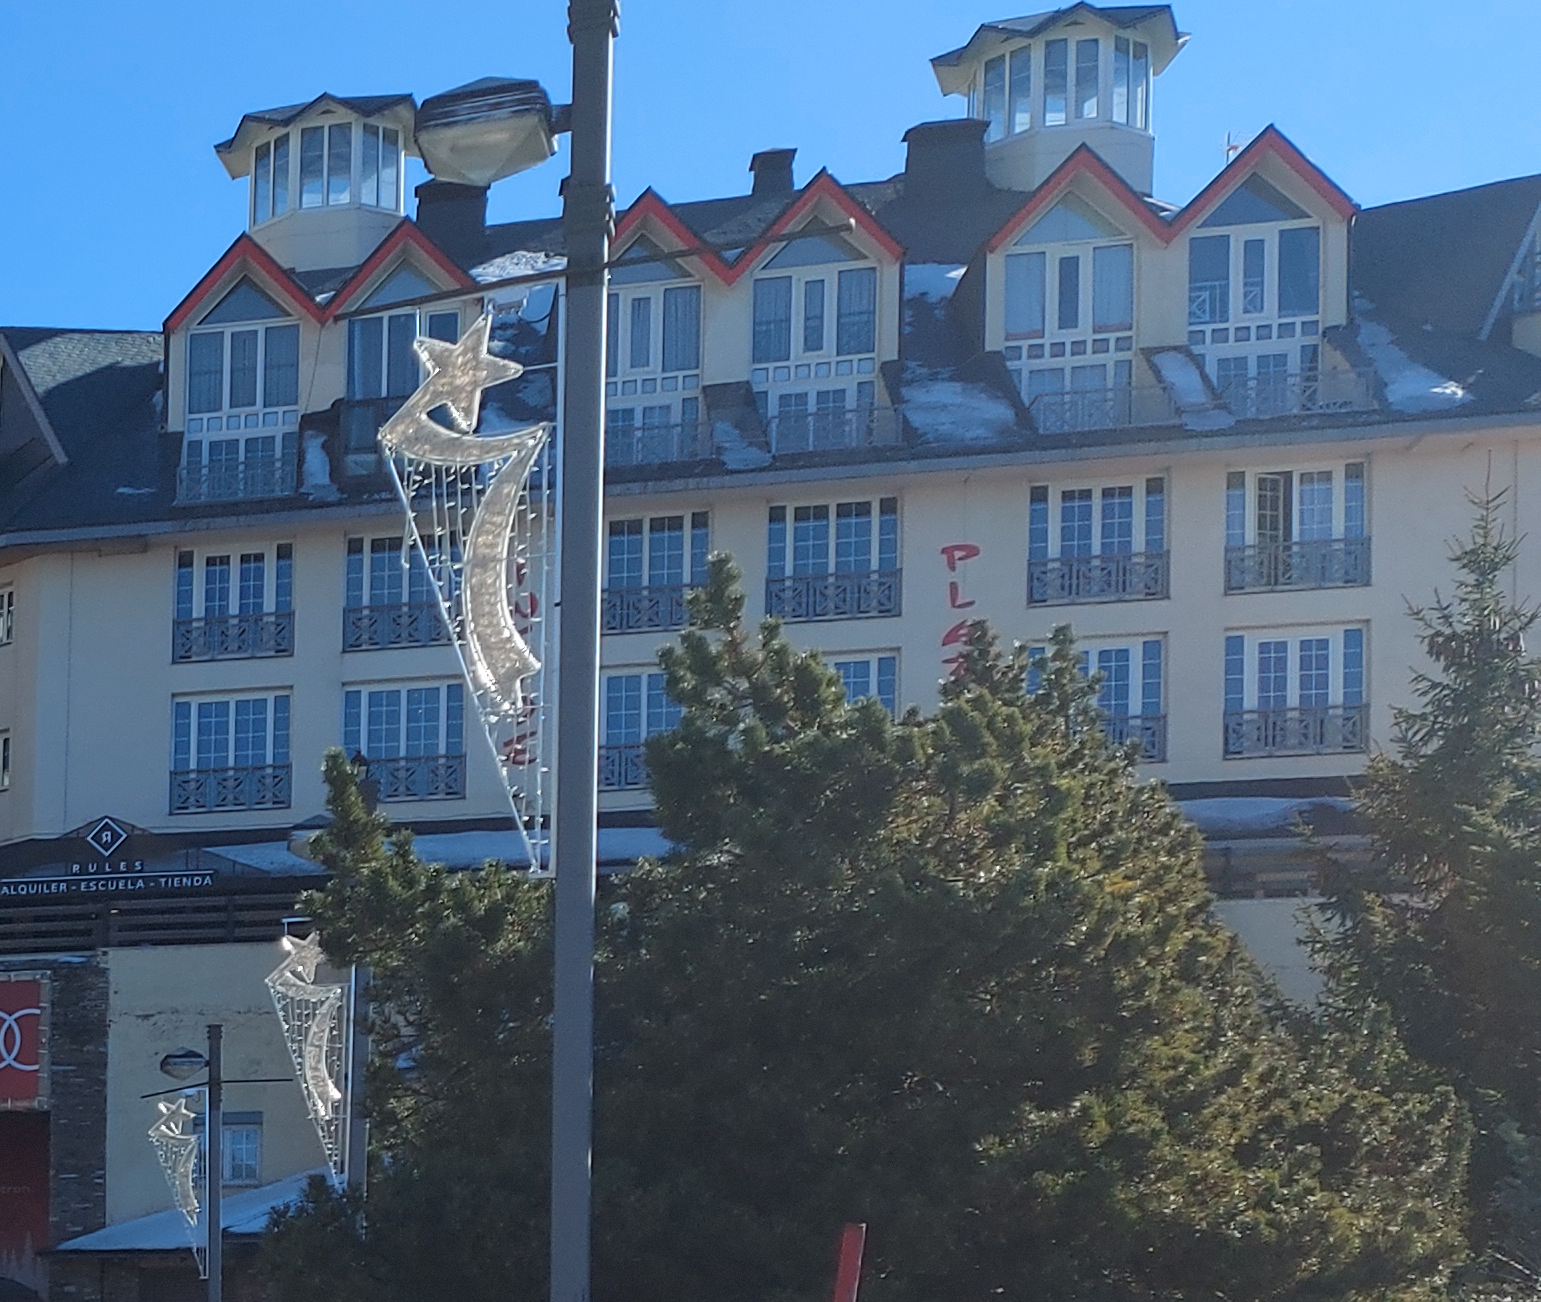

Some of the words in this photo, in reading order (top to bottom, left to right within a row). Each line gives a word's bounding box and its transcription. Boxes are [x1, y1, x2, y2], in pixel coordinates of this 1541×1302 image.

[72, 860, 143, 874] RULES
[0, 883, 67, 895] ALQUILER
[80, 878, 145, 892] ESCUELA
[159, 876, 213, 888] TIENDA
